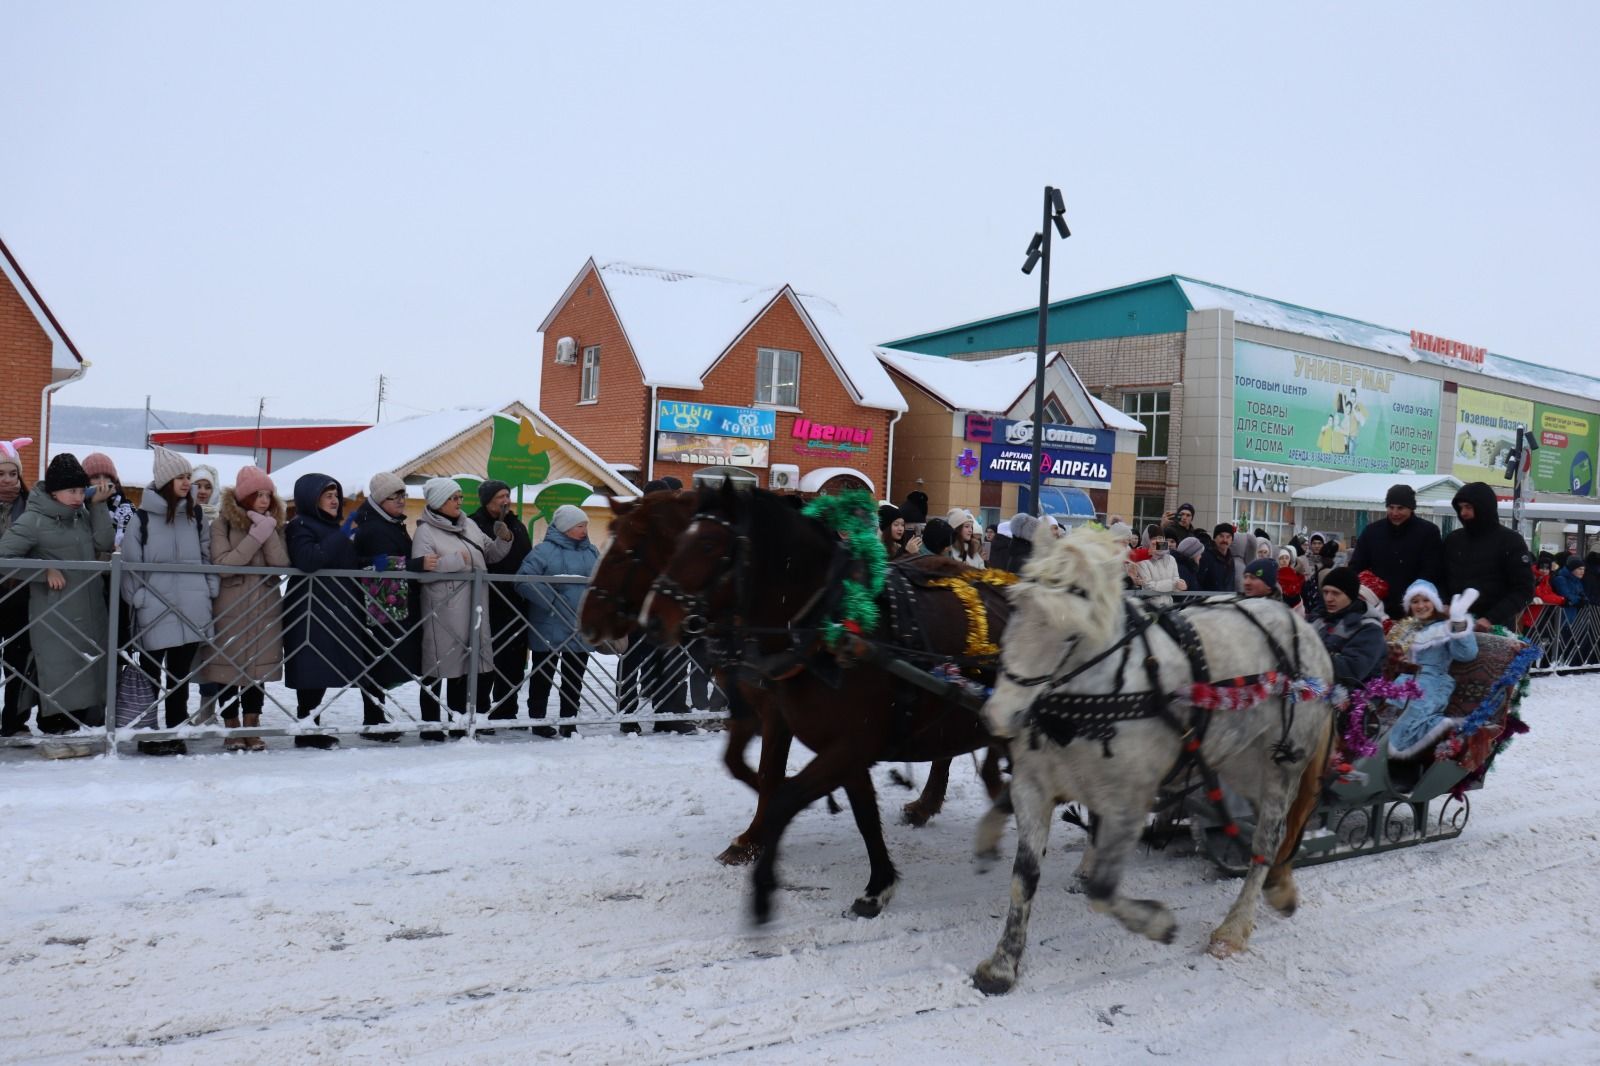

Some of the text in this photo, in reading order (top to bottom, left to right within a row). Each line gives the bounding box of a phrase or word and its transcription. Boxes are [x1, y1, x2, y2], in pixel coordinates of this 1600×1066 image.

[1294, 354, 1395, 393] УНИВЕРМАГ
[1282, 384, 1308, 397] ЦЕНТР
[661, 403, 712, 421] АЛТЫН
[1247, 400, 1288, 418] ТОВАРЫ
[721, 418, 773, 436] КӨМЕШ
[1237, 417, 1294, 437] ДЛЯ СЕМЬИ
[1460, 409, 1498, 428] Төзелеш
[792, 417, 873, 444] Цветы
[1246, 437, 1284, 453] И ДОМА
[990, 459, 1031, 473] АПТЕКА
[1051, 459, 1108, 478] АПРЕЛЬ
[1390, 456, 1429, 470] ТОВАРЛАР
